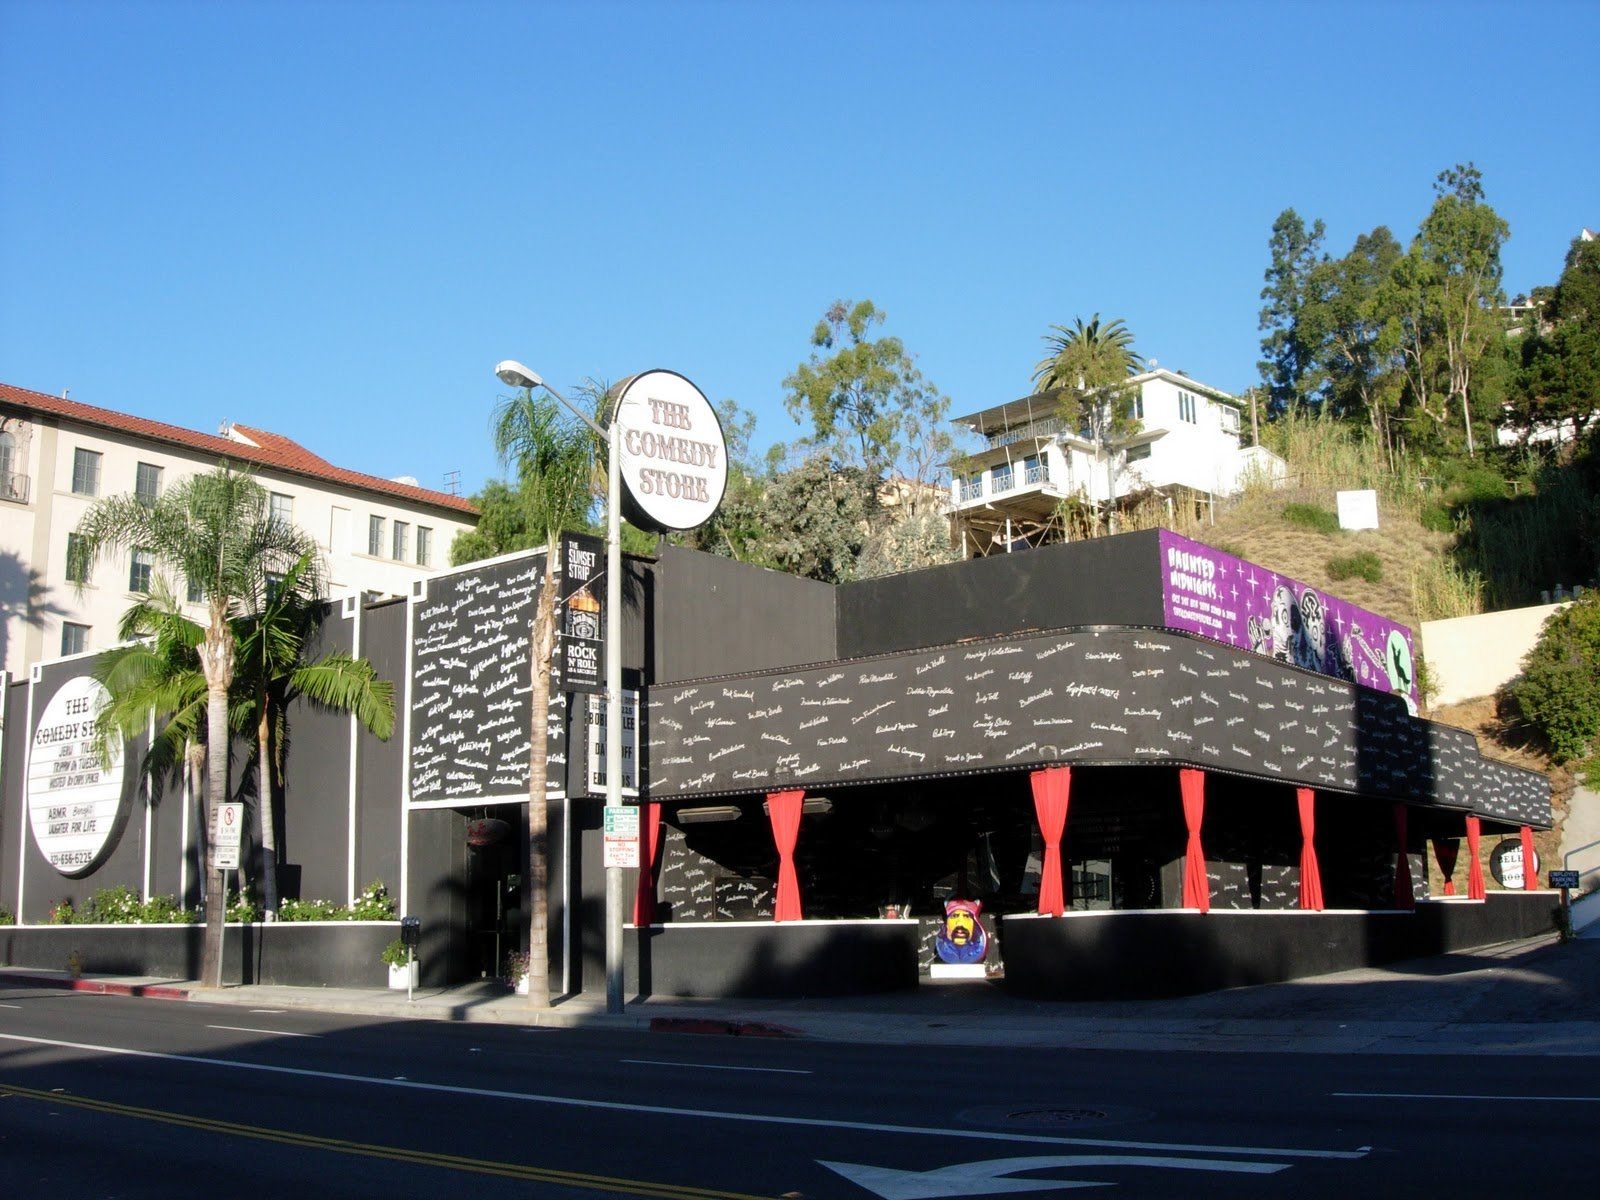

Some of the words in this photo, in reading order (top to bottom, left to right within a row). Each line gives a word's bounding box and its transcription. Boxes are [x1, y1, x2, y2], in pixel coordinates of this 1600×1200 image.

[648, 398, 692, 431] THE
[625, 429, 718, 469] COMEDY
[640, 467, 709, 503] STORE
[568, 541, 579, 550] THE
[568, 549, 597, 568] SUNSET
[1168, 547, 1215, 580] HAUNTED
[568, 564, 590, 581] STRIP
[1170, 570, 1217, 600] MIDNIGHTS
[567, 644, 597, 661] ROCK
[577, 658, 598, 670] ROLL
[66, 697, 89, 715] THE
[623, 717, 635, 731] LEE
[36, 723, 80, 745] COMEDY
[82, 820, 97, 833] LIFE
